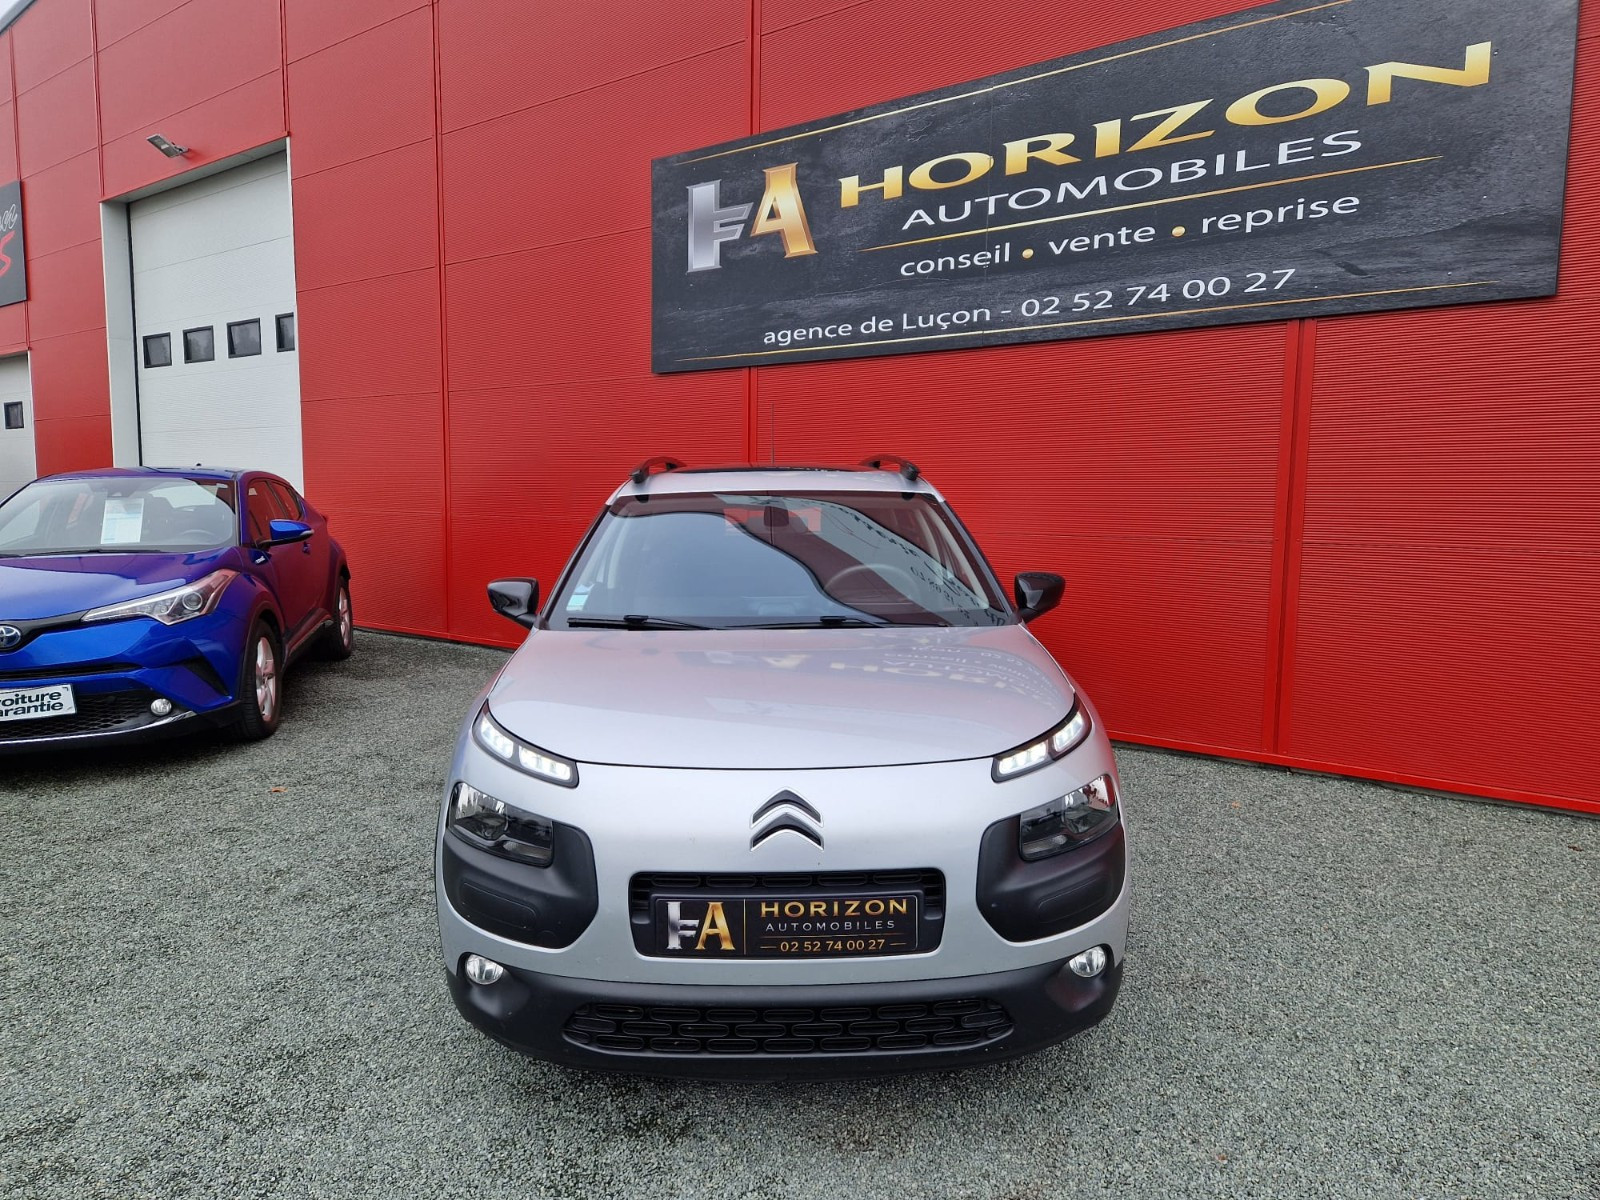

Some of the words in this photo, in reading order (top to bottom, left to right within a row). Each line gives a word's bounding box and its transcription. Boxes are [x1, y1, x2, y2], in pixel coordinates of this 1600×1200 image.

[838, 41, 1492, 208] HORIZON
[902, 130, 1362, 230] AUTOMOBILES
[900, 242, 1010, 276] conseil
[1048, 226, 1156, 255] vente
[1201, 196, 1360, 233] reprise
[763, 323, 852, 346] agence
[860, 316, 894, 334] de
[902, 308, 991, 329] Luçon
[1021, 296, 1060, 317] 02
[1071, 290, 1113, 312] 52
[1126, 283, 1171, 306] 74
[1182, 276, 1231, 300] 00
[1243, 269, 1296, 293] 27
[0, 691, 62, 707] oiture
[0, 701, 64, 716] rantie
[760, 898, 908, 918] HORIZON
[765, 920, 896, 932] AUTOMOBILES
[780, 941, 799, 952] 02
[803, 940, 822, 952] 52
[825, 940, 842, 951] 74
[846, 939, 865, 951] 00
[868, 938, 886, 950] 27
